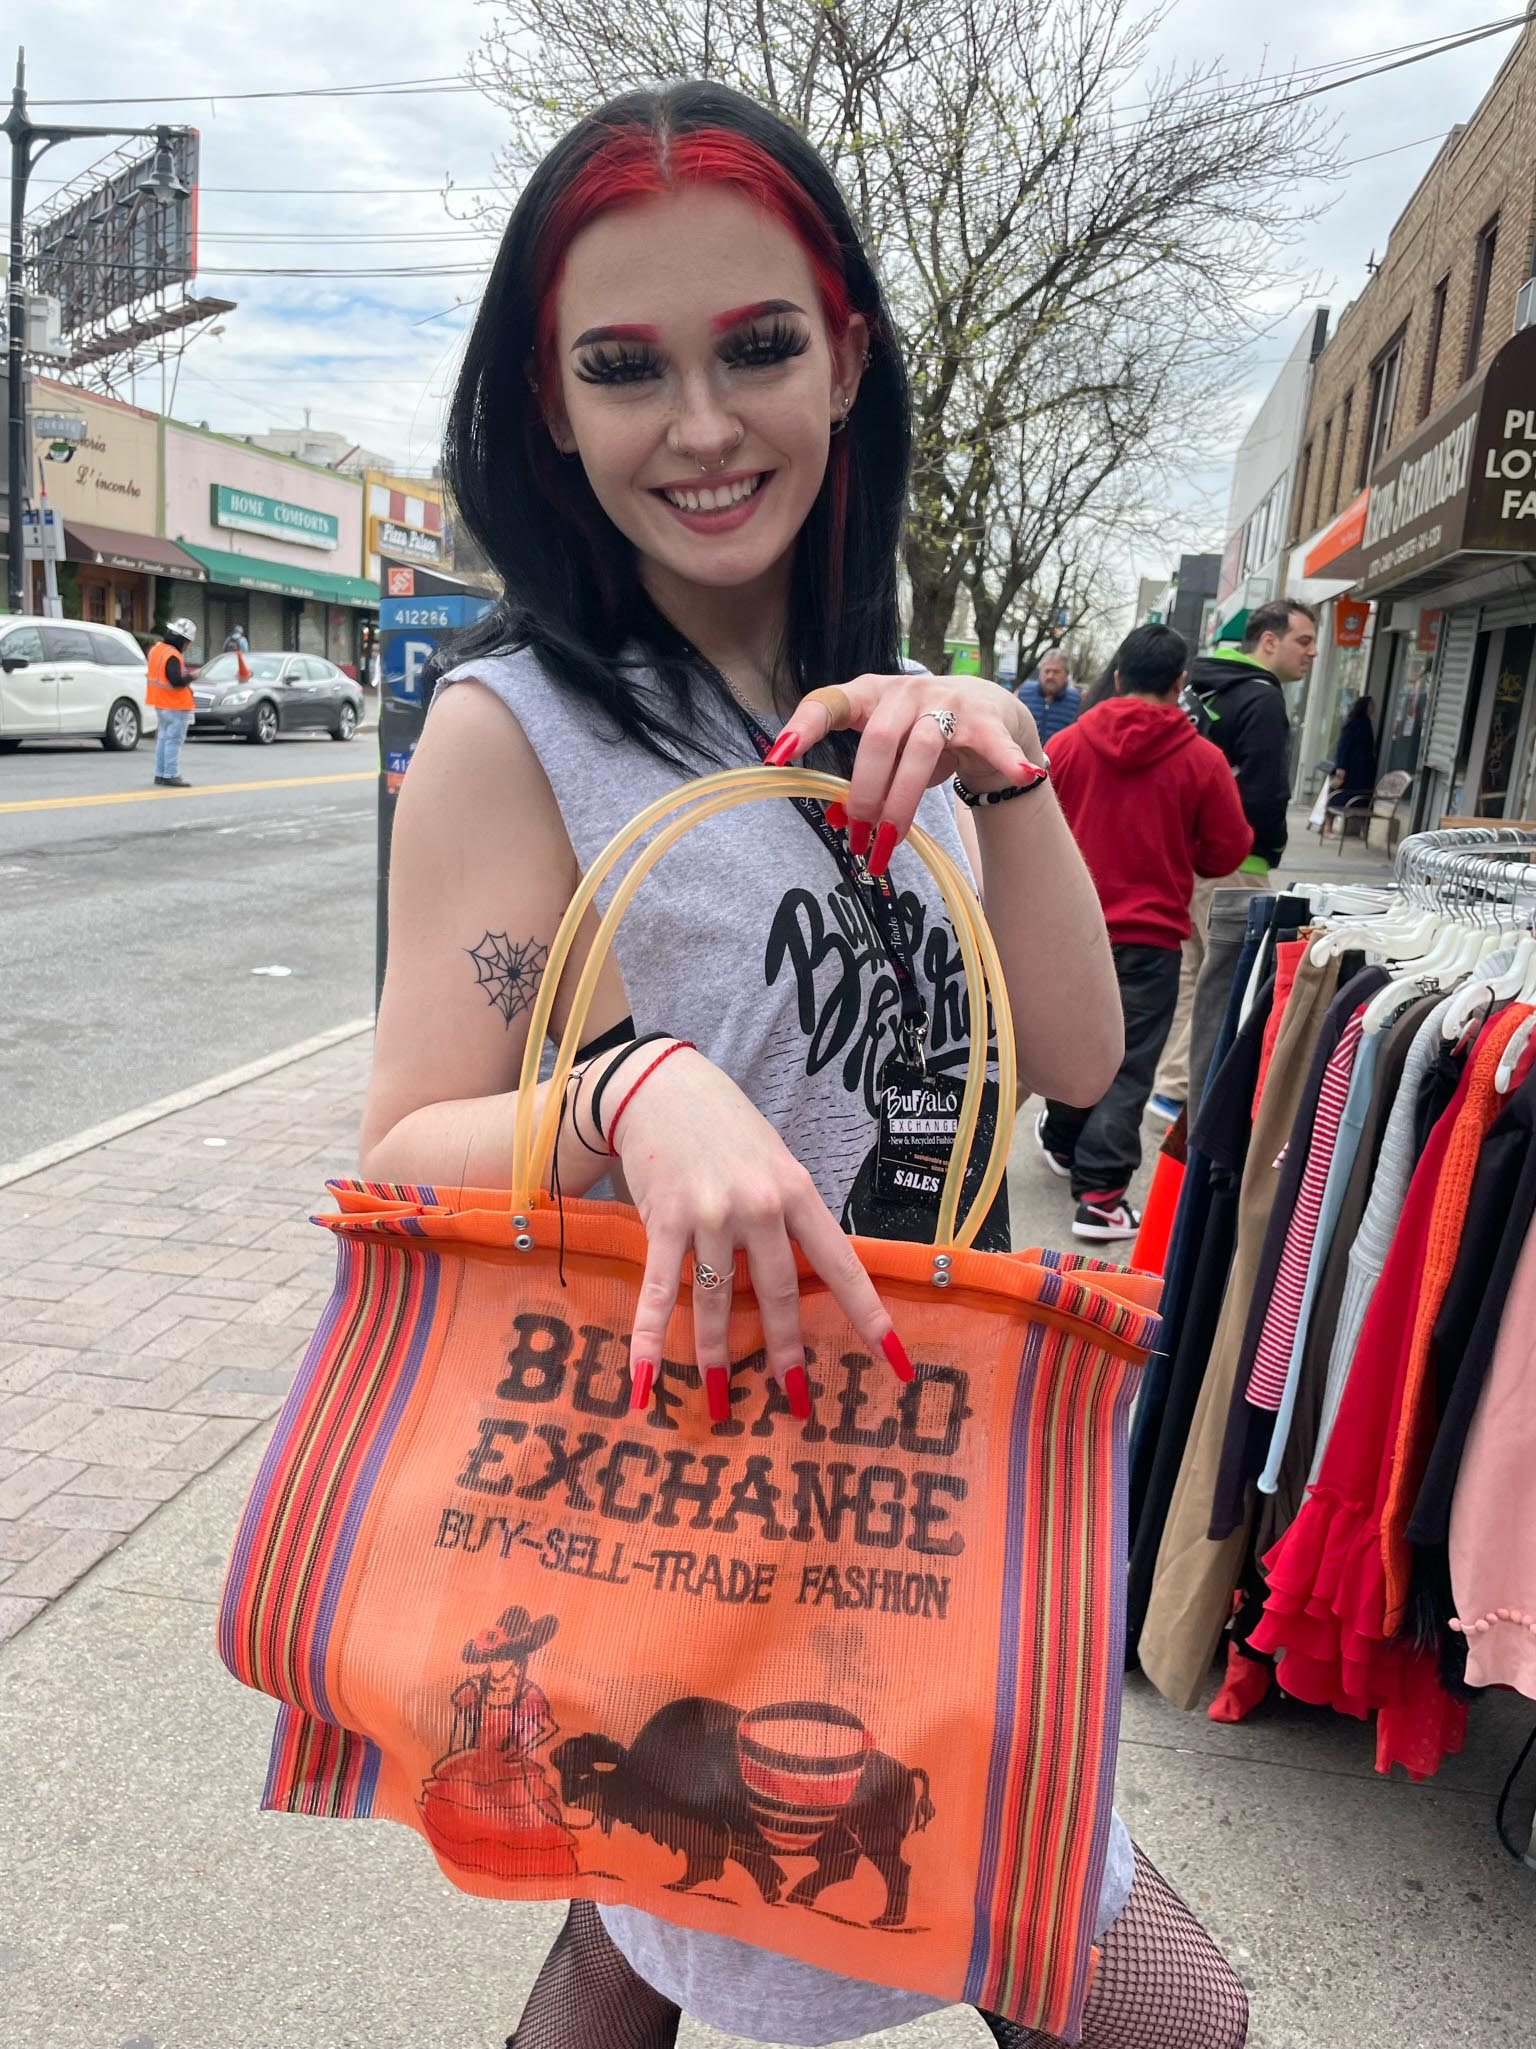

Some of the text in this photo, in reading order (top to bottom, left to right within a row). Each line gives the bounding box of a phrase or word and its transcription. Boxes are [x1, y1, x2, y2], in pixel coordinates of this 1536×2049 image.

[230, 493, 329, 534] HOME COMFORTS
[395, 609, 448, 626] 412286
[404, 641, 433, 693] P
[888, 916, 902, 949] Trade
[890, 1120, 957, 1131] EXCHANGE
[890, 1135, 904, 1145] New
[911, 1135, 936, 1147] Recycled
[936, 1135, 955, 1145] Fashio
[893, 1169, 940, 1193] SALES
[456, 1417, 969, 1557] EXCHANGE
[434, 1507, 951, 1620] BUY-SELL-TRADE FASHION
